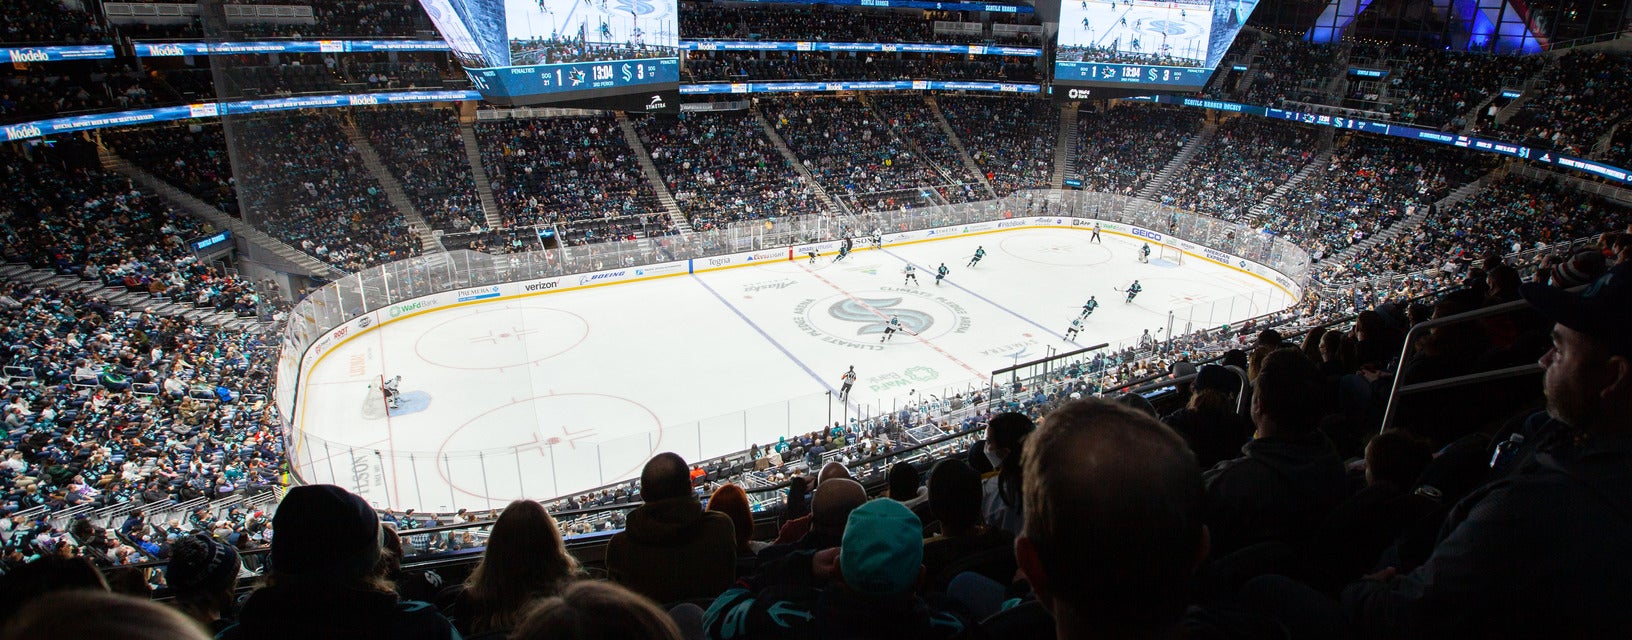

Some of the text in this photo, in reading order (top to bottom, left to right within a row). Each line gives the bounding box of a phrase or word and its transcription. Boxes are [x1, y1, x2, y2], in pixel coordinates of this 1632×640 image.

[10, 50, 49, 62] Modelo
[150, 45, 184, 56] Modelo
[556, 69, 563, 86] 1
[592, 65, 614, 80] 13:04
[637, 64, 644, 80] 3
[1092, 66, 1097, 78] 1
[1122, 66, 1140, 78] 13:04
[1163, 69, 1170, 81] 3
[350, 95, 378, 105] Modelo
[1184, 98, 1203, 107] SEATTLE
[6, 126, 42, 141] Modelo
[1132, 227, 1162, 242] GEICO
[1203, 248, 1230, 260] AMERICAN
[1206, 253, 1230, 265] EXPRESS
[591, 270, 626, 280] BOEING
[525, 280, 558, 292] verizon
[880, 286, 934, 298] CLIMATE
[458, 288, 490, 298] PREMERA
[401, 298, 438, 313] WaFd Bank
[333, 326, 348, 340] ROOT
[822, 335, 884, 352] CLIMATE
[352, 456, 370, 495] ILSON
